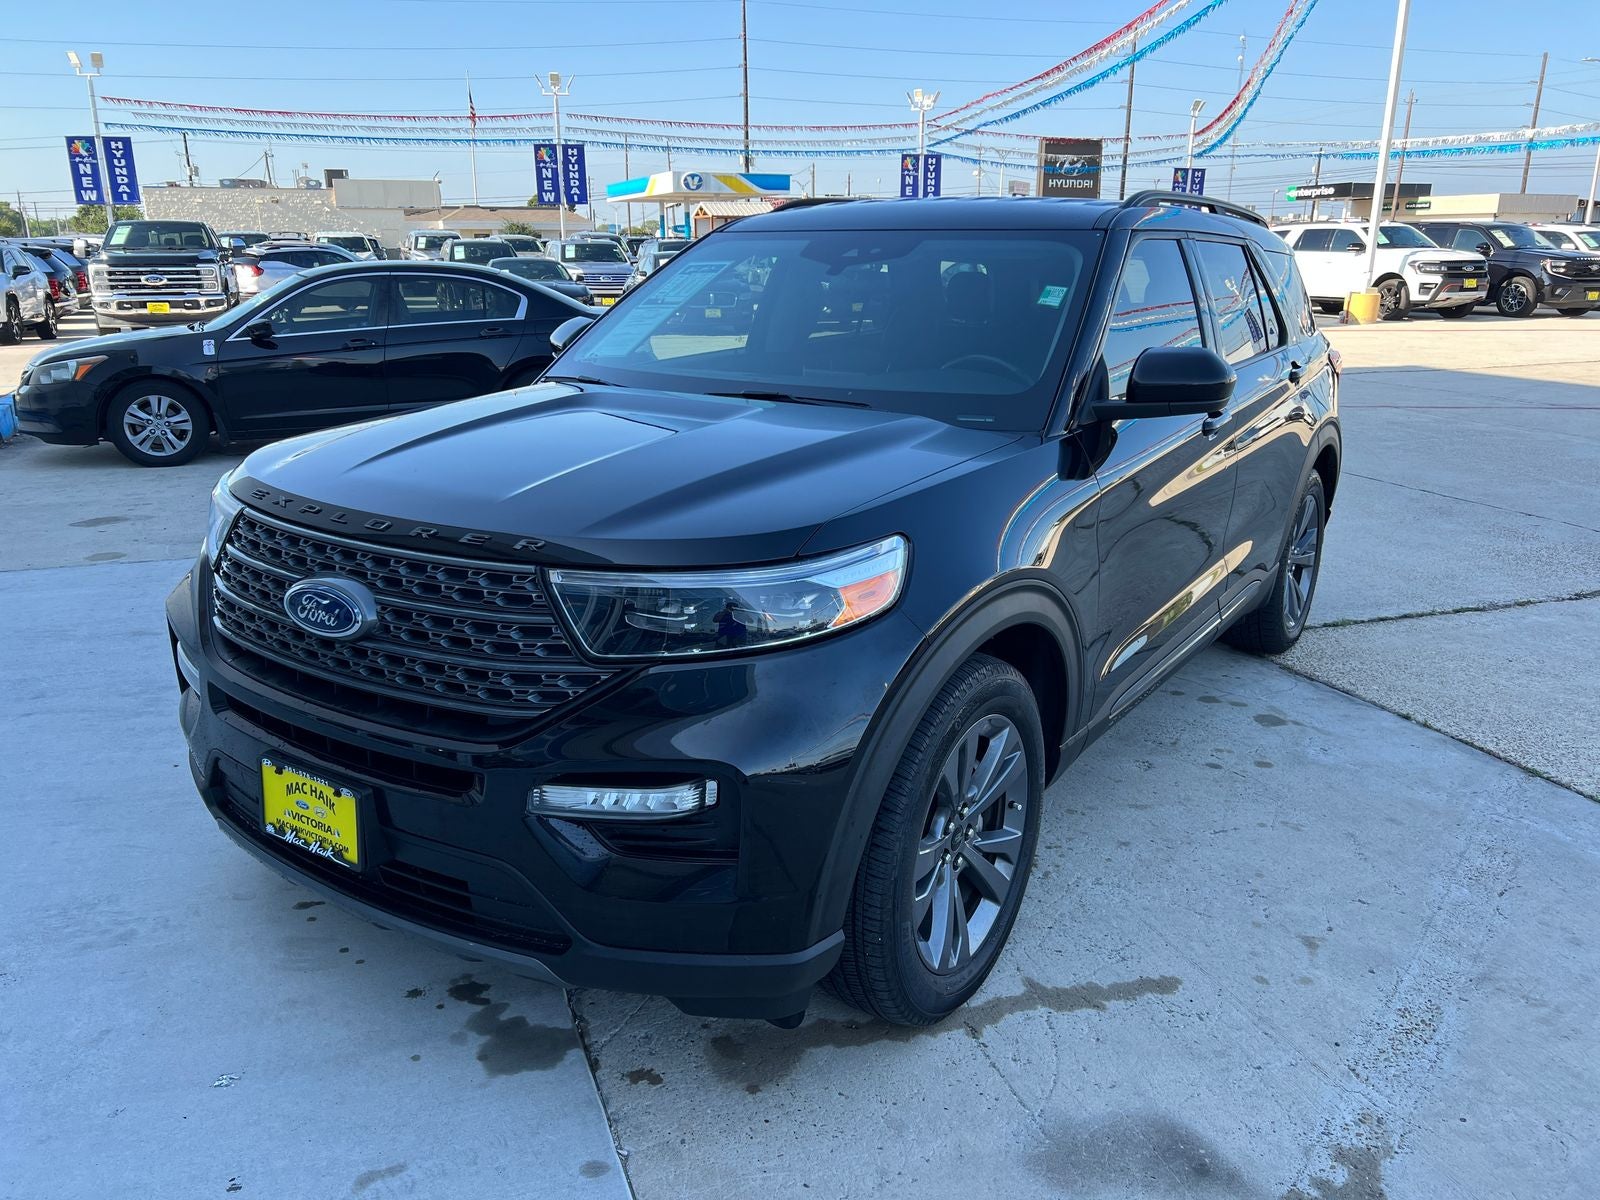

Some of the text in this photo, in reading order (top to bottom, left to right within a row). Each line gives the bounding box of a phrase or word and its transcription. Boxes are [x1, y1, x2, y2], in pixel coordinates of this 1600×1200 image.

[78, 163, 97, 201] NEW
[110, 141, 131, 201] HYUNDAI
[541, 168, 555, 202] NEW
[567, 148, 580, 202] HYUNDAI
[905, 175, 914, 196] NE
[928, 157, 936, 198] HYUNDA
[1048, 179, 1093, 188] HYUNDAI
[1286, 186, 1335, 198] enterprise
[251, 488, 546, 551] EXPLORER
[298, 594, 340, 627] Ford
[286, 782, 336, 816] MAC HAIK
[290, 810, 333, 835] VICTORIA
[283, 829, 335, 858] Mac Haik
